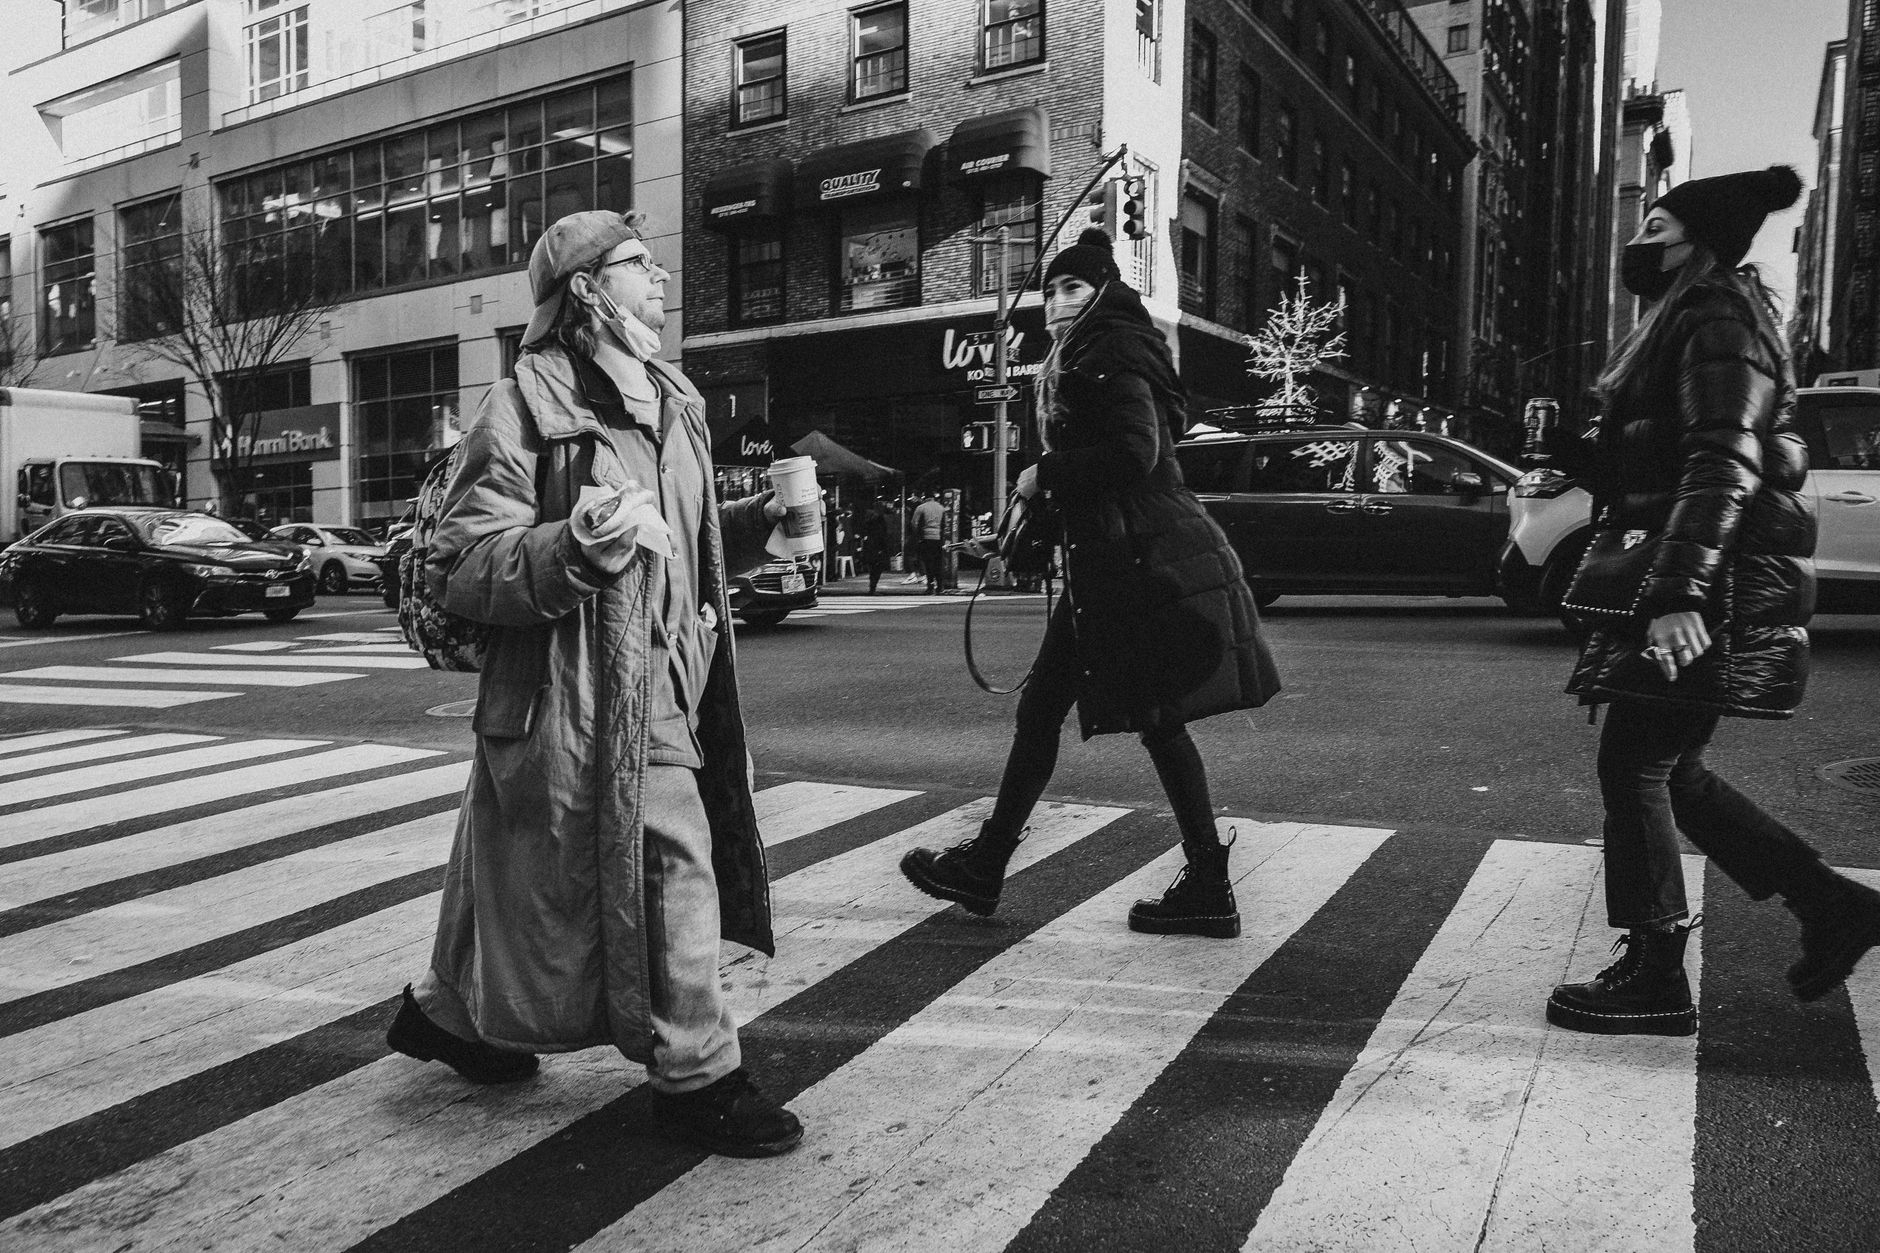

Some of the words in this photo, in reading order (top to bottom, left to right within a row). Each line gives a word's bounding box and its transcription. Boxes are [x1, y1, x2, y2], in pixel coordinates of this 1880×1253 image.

[820, 168, 882, 193] QUALITY
[967, 366, 1012, 381] KON
[980, 390, 994, 398] ONE
[288, 426, 334, 453] Bank
[741, 434, 774, 456] love
